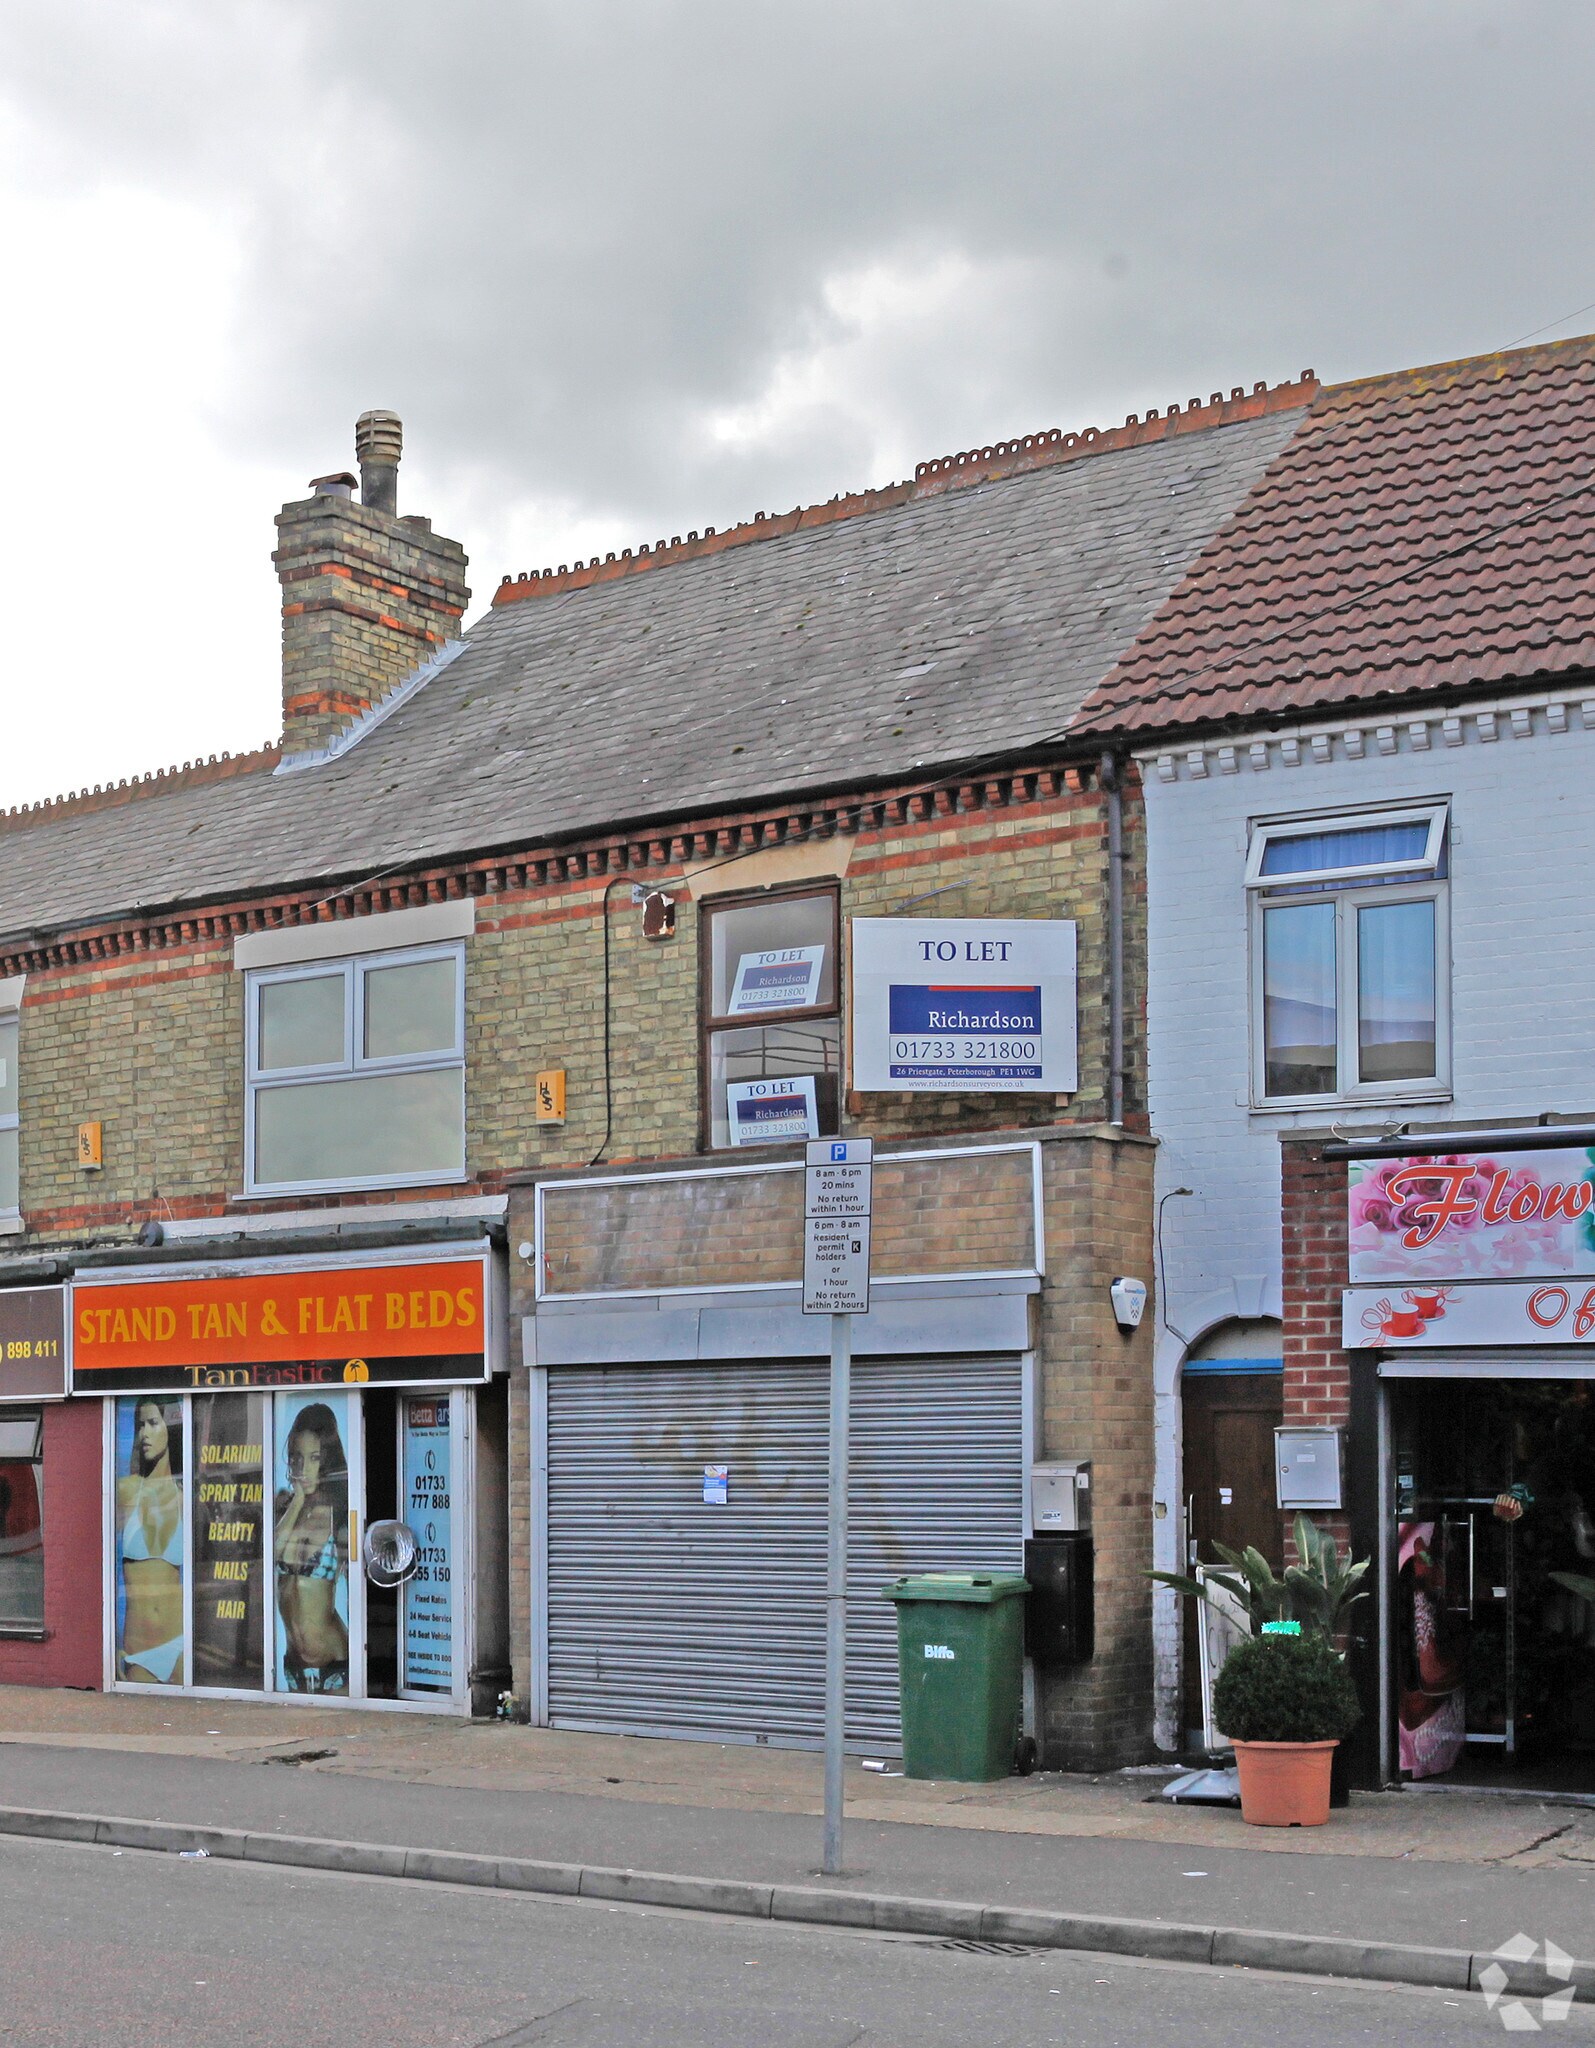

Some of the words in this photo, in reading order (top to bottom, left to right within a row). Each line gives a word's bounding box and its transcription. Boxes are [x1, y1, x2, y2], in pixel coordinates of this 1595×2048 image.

[758, 953, 776, 964] TO
[781, 949, 805, 962] LET
[919, 941, 957, 962] TO
[965, 941, 1012, 962] LET
[759, 974, 807, 986] Richardson
[741, 991, 769, 1001] 01733
[772, 987, 805, 998] 321800
[928, 1010, 1035, 1029] Richardson
[895, 1041, 955, 1059] 01733
[964, 1041, 1036, 1059] 321800
[908, 1068, 946, 1077] Priestgate,
[947, 1068, 996, 1077] Peterborough
[1000, 1068, 1013, 1076] PE1
[1017, 1068, 1035, 1076] 1WG
[747, 1084, 767, 1097] TO
[772, 1081, 795, 1094] LET
[908, 1080, 1025, 1088] www.richardsonsurveyors.co.uk
[755, 1107, 804, 1120] Richardson
[741, 1125, 769, 1136] 01733
[773, 1122, 806, 1133] 321800
[834, 1145, 845, 1160] P
[815, 1169, 821, 1177] 8
[841, 1168, 847, 1176] 6
[849, 1169, 861, 1178] pm
[821, 1181, 833, 1189] 20
[835, 1181, 855, 1189] mins
[818, 1195, 829, 1203] No
[811, 1205, 836, 1213] within
[845, 1204, 864, 1212] hour
[814, 1221, 820, 1229] 6
[821, 1222, 834, 1230] pm
[841, 1220, 847, 1228] 8
[813, 1233, 849, 1242] Resident
[817, 1243, 844, 1252] permit
[852, 1242, 860, 1251] K
[815, 1253, 846, 1261] holders
[829, 1278, 848, 1286] hour
[815, 1291, 828, 1299] No
[830, 1291, 856, 1299] return
[806, 1301, 831, 1309] within
[834, 1301, 839, 1309] 2
[841, 1301, 864, 1309] hours
[79, 1307, 176, 1344] STAND
[187, 1302, 247, 1339] TAN
[260, 1299, 288, 1336] &
[298, 1295, 373, 1333] FLAT
[385, 1288, 477, 1330] BEDS
[7, 1341, 31, 1359] 898
[35, 1340, 58, 1357] 411
[184, 1361, 333, 1387] TanFastic
[201, 1445, 262, 1464] SOLARIUM
[415, 1475, 445, 1490] 01733
[199, 1484, 236, 1503] SPRAY
[240, 1484, 263, 1503] TAN
[411, 1494, 429, 1509] 777
[432, 1494, 450, 1509] 888
[208, 1523, 254, 1542] BEAUTY
[416, 1547, 446, 1563] 01733
[213, 1562, 248, 1581] NAILS
[433, 1567, 451, 1582] 150
[415, 1594, 430, 1603] Fixed
[431, 1595, 447, 1604] Rates
[216, 1601, 245, 1619] HAIR
[410, 1612, 416, 1620] 24
[418, 1612, 431, 1621] Hour
[924, 1644, 955, 1659] Biffa
